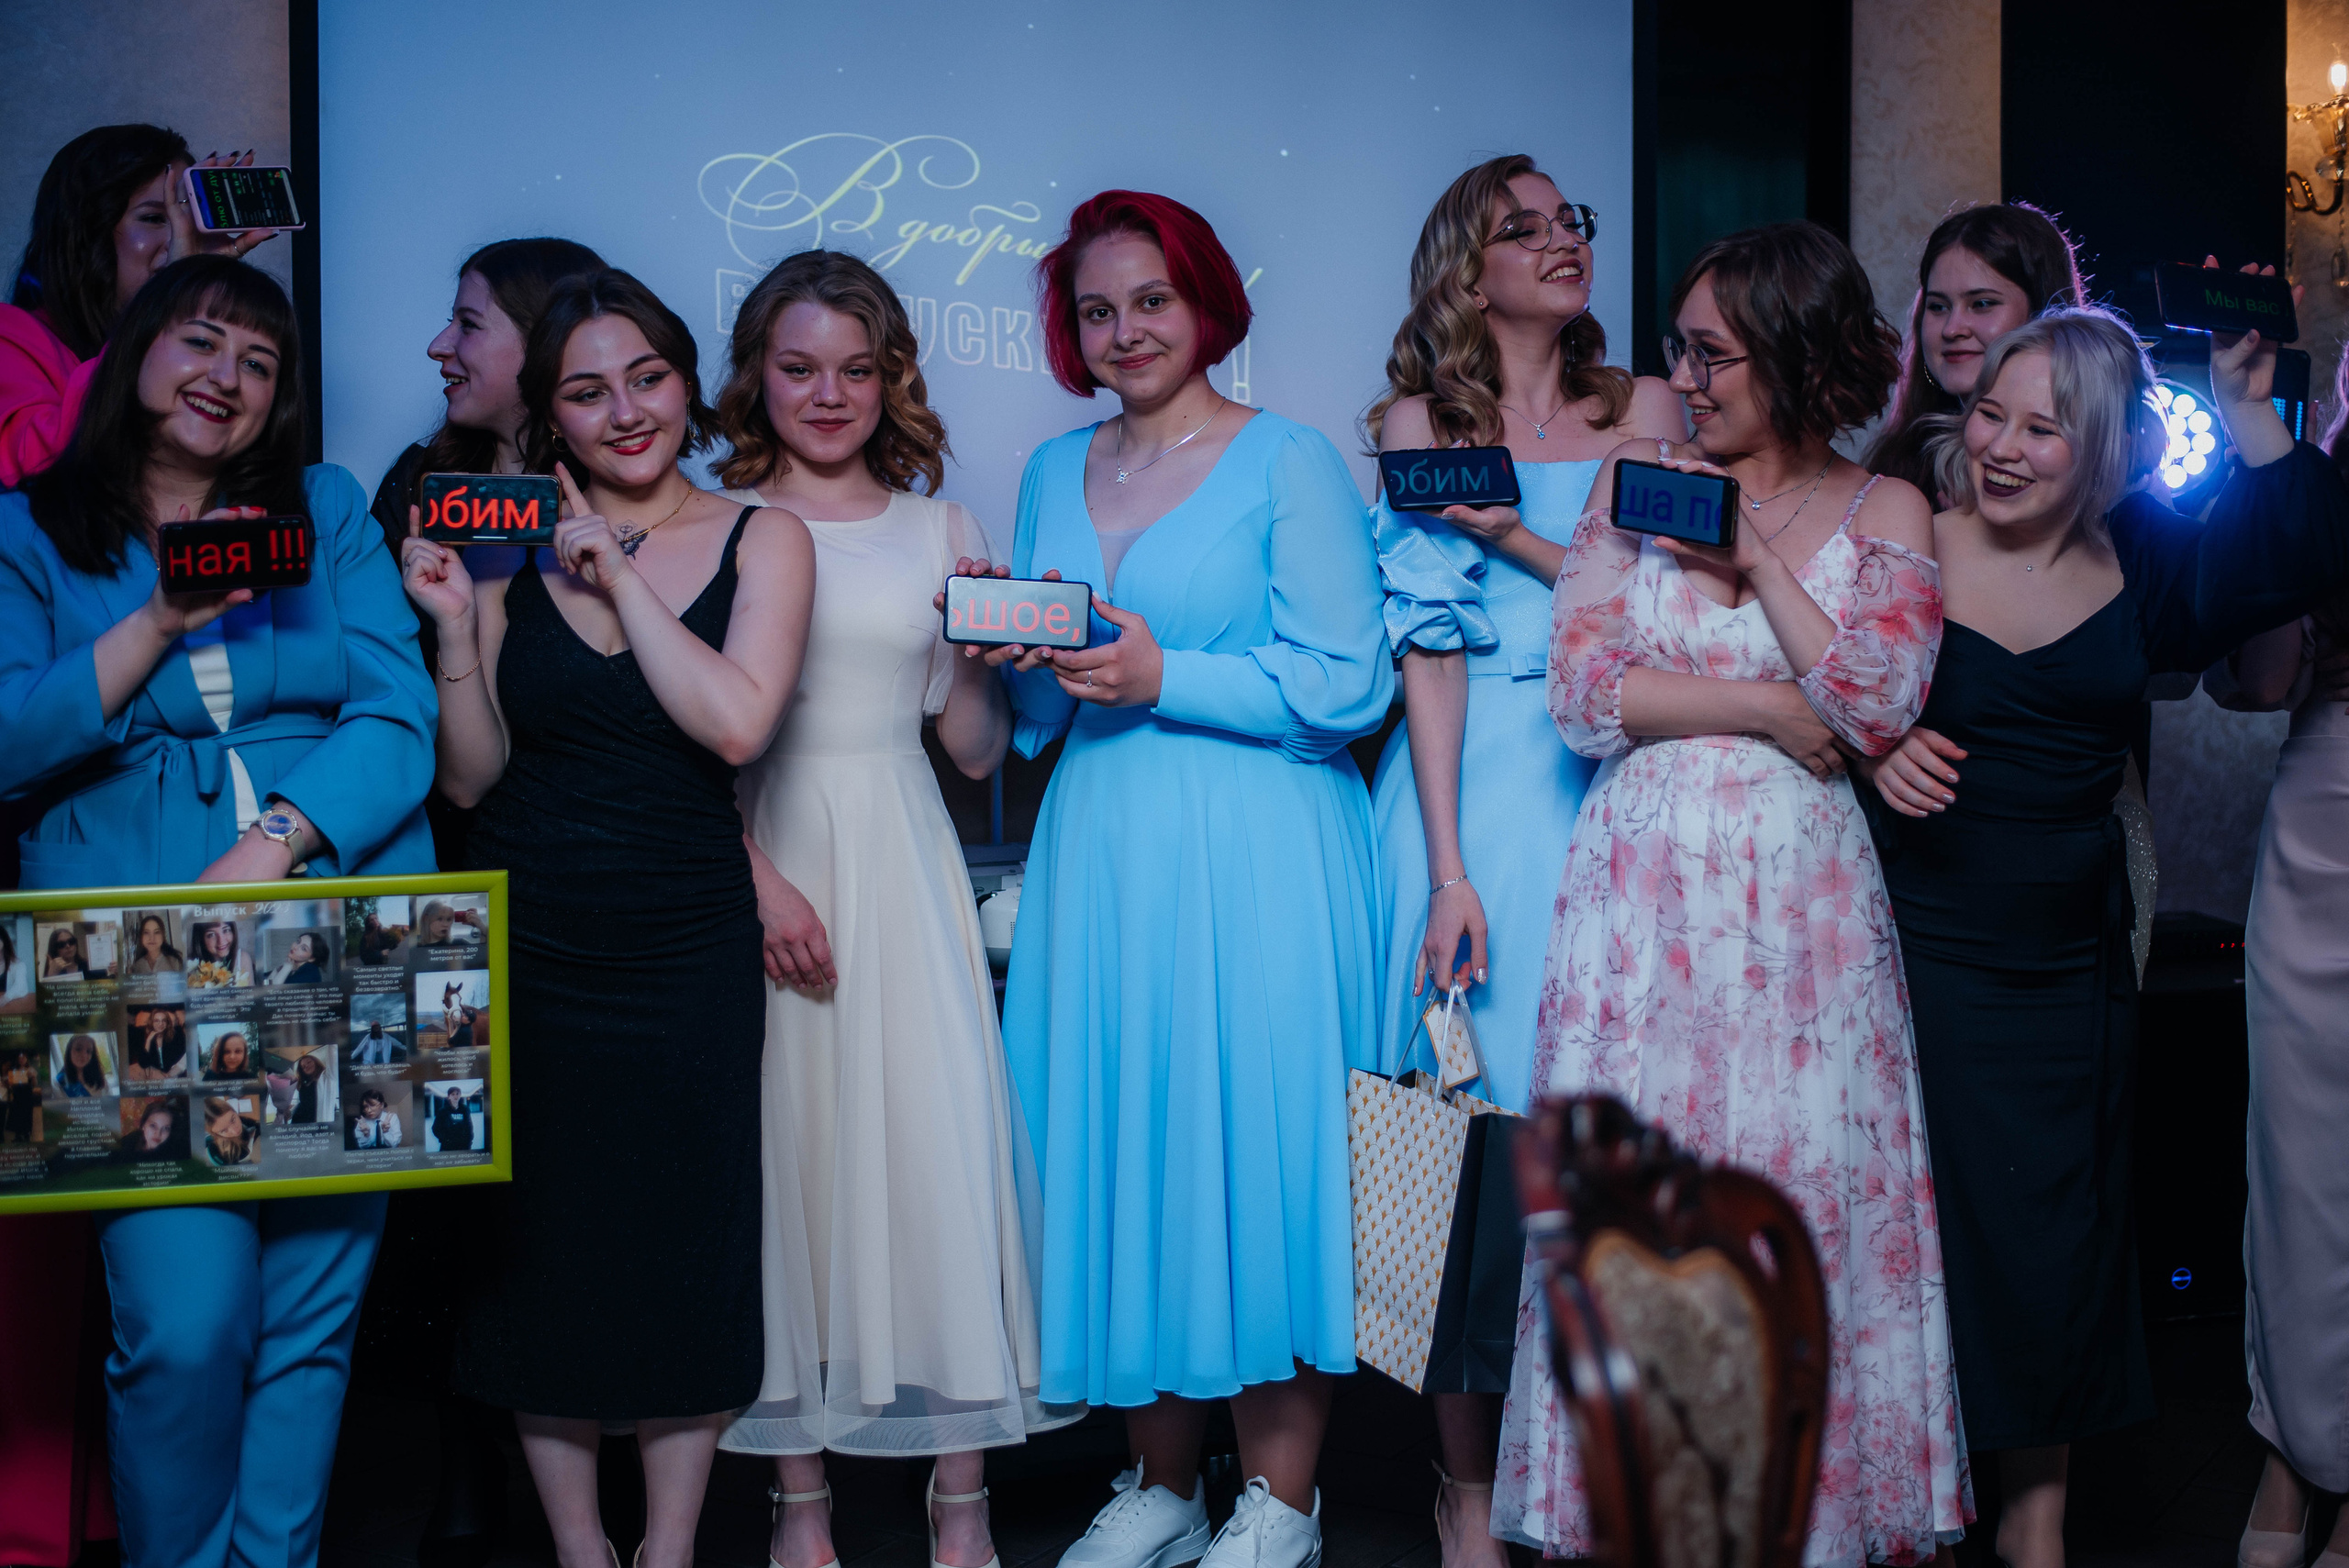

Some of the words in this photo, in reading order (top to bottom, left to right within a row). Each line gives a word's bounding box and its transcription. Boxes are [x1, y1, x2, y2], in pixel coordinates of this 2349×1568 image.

[207, 171, 219, 187] ду
[2205, 288, 2240, 309] Мы
[2245, 298, 2281, 316] вас
[168, 541, 252, 577] ная
[268, 528, 306, 571] !!!
[194, 906, 247, 918] Выпуск
